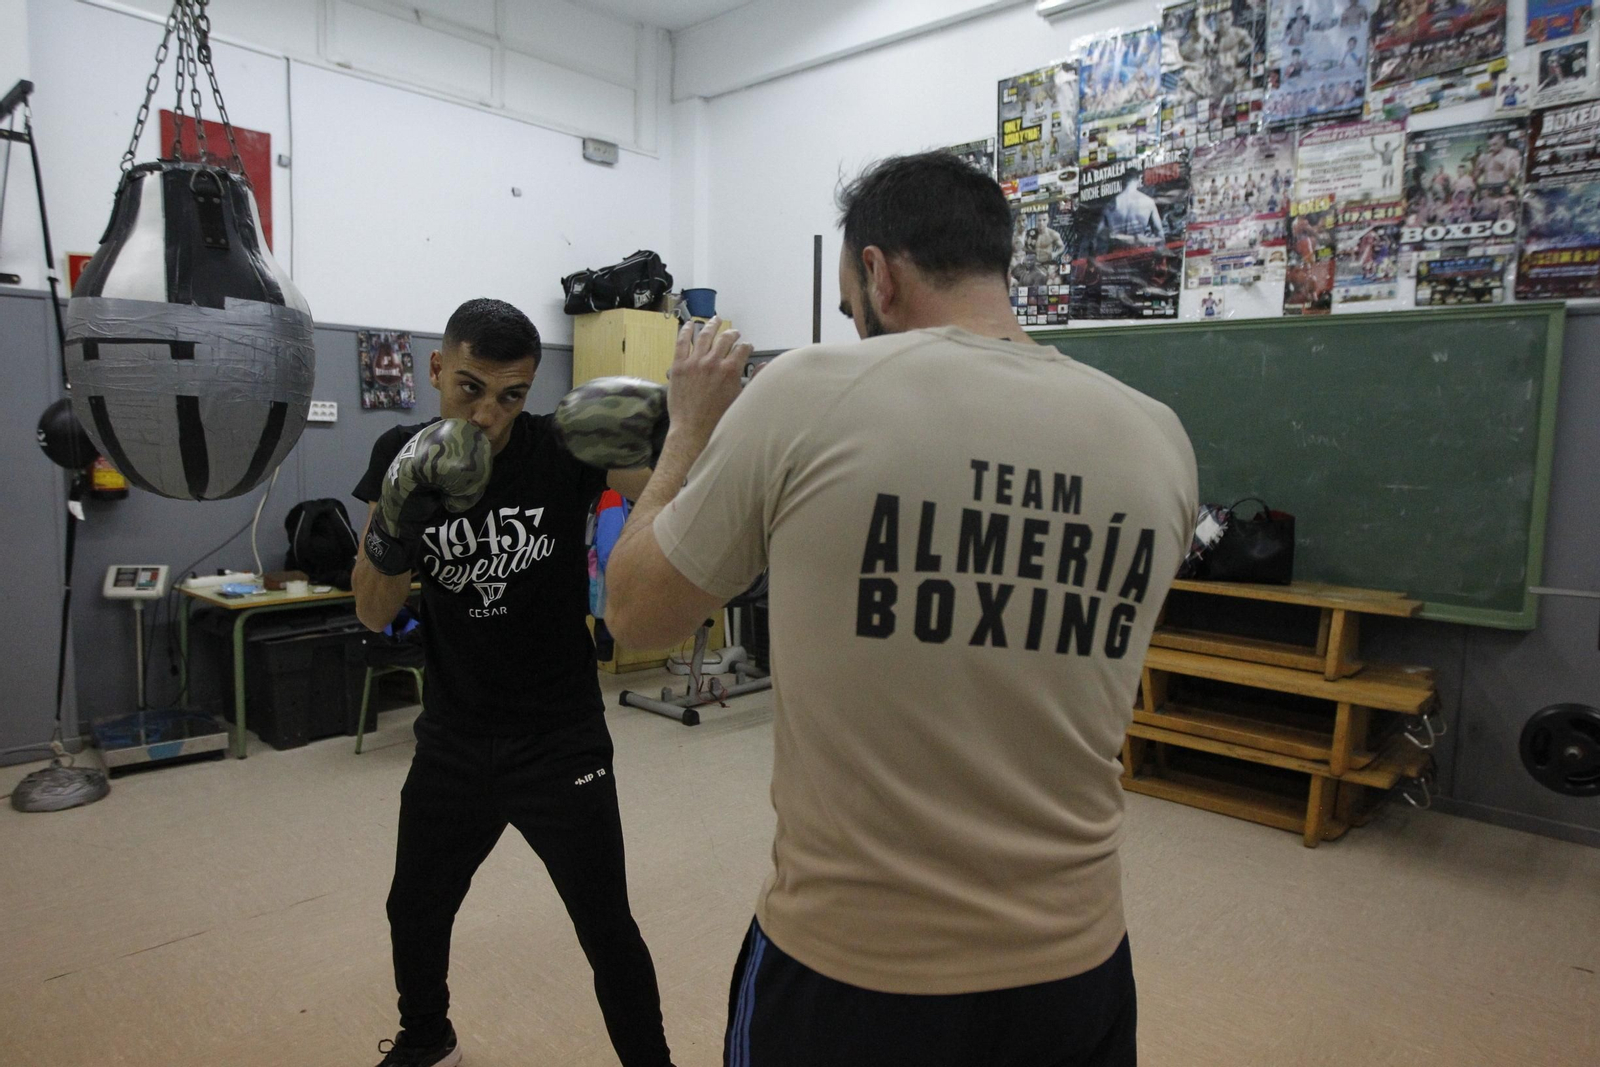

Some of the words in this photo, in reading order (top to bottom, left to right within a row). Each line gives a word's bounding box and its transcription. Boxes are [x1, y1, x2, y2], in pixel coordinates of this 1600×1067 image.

[1541, 106, 1600, 135] BOXEO
[1083, 171, 1093, 186] LA
[1094, 161, 1126, 182] BATALLA
[1080, 185, 1100, 202] NOCHE
[1400, 219, 1516, 243] BOXEO
[970, 459, 1083, 515] TEAM
[860, 493, 1156, 603] ALMERÍA
[856, 577, 1137, 660] BOXING
